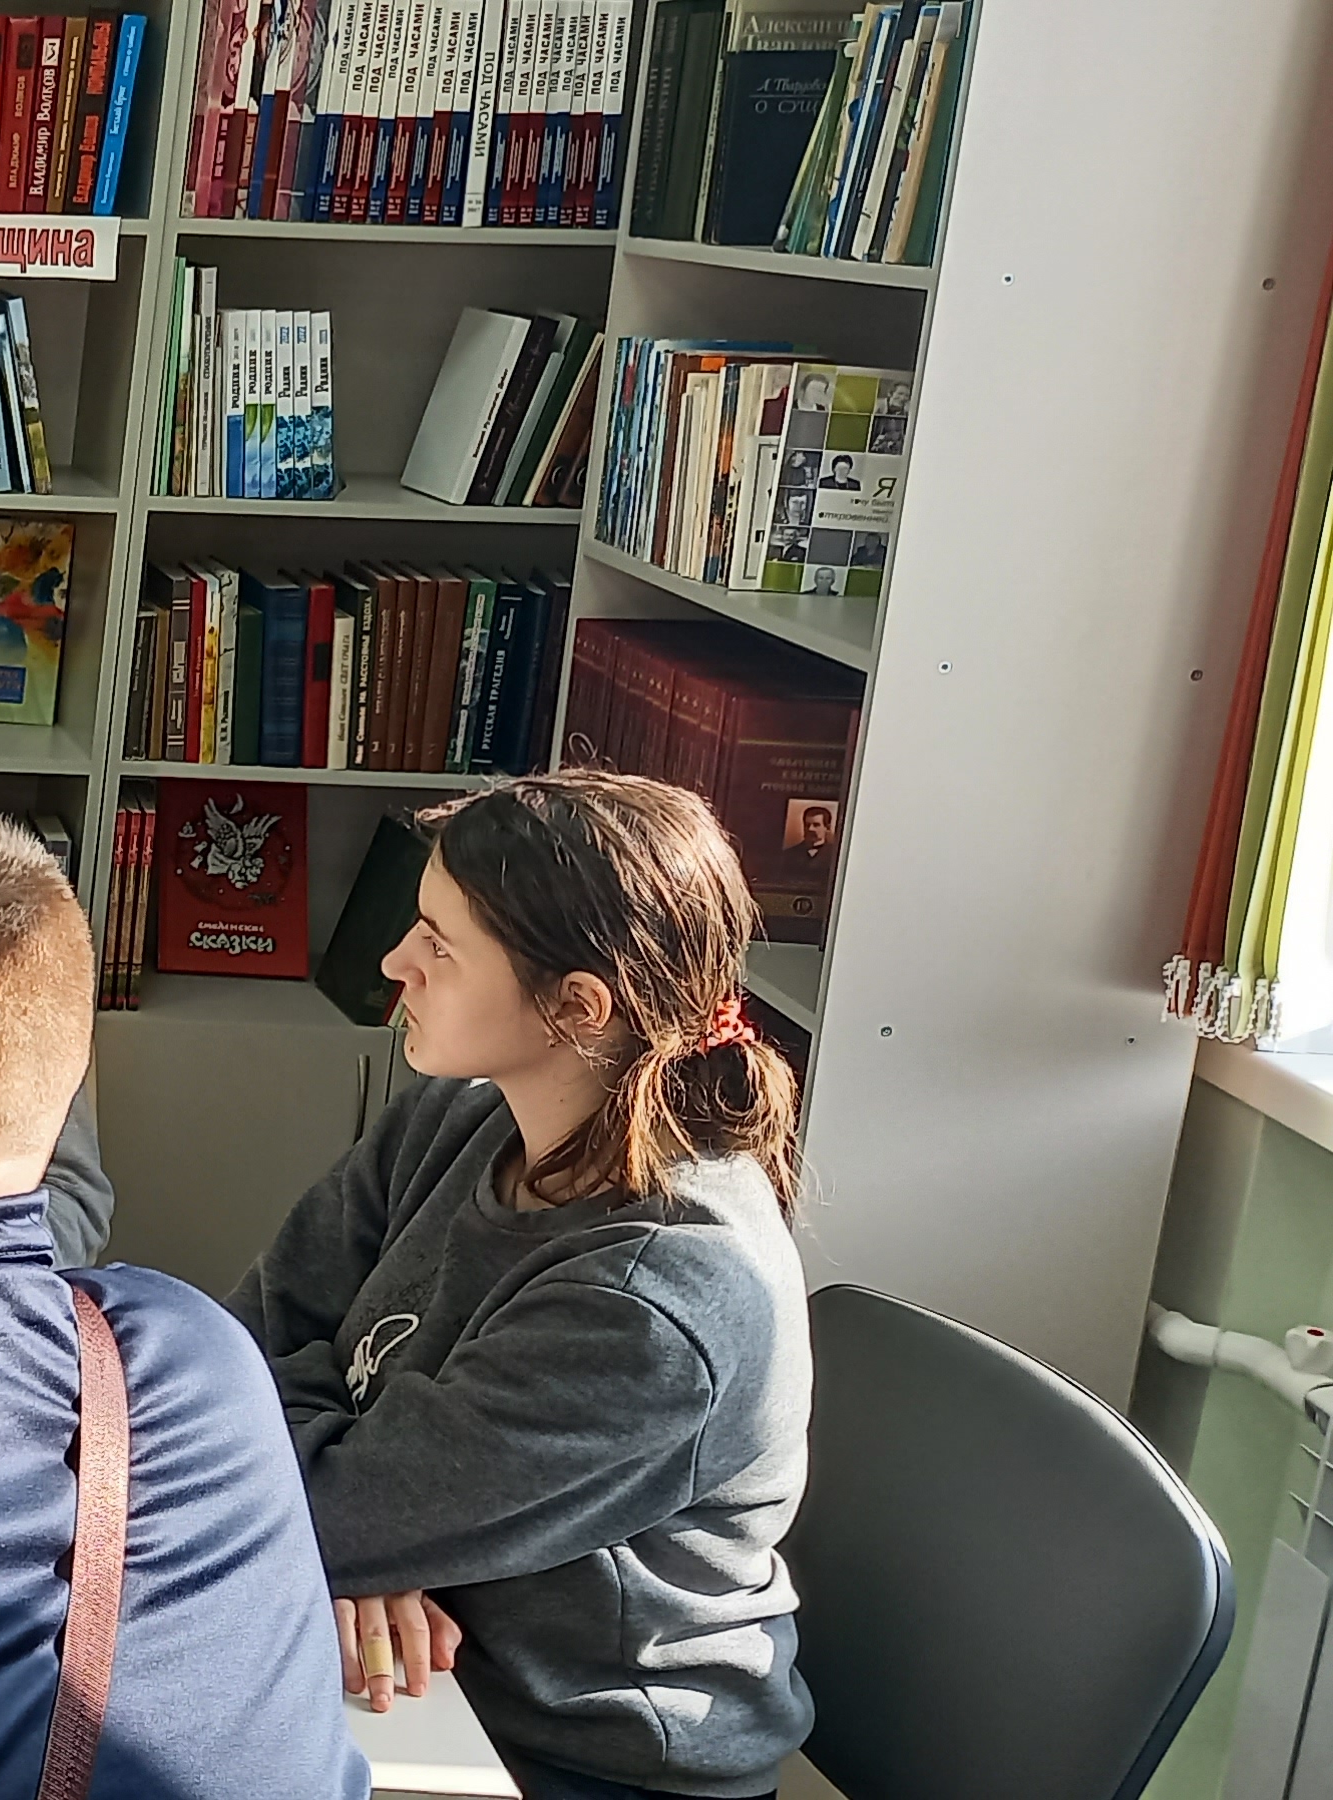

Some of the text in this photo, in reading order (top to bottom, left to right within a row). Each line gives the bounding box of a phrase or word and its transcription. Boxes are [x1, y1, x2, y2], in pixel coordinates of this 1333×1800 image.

[339, 4, 355, 73] ПОД ЧАСАМИ
[352, 2, 373, 90] ПОД ЧАСАМИ
[369, 4, 389, 92] ПОД ЧАСАМИ
[388, 9, 404, 78] ПОД ЧАСАМИ
[405, 3, 424, 92] ПОД ЧАСАМИ
[426, 7, 442, 76] ПОД ЧАСАМИ
[442, 11, 461, 93] ПОД ЧАСАМИ
[460, 12, 478, 94] ПОД ЧАСАМИ
[503, 17, 518, 92] ПОД ЧАСАМИ
[518, 14, 536, 95] ПОД ЧАСАМИ
[536, 13, 553, 95] ПОД ЧАСАМИ
[550, 17, 565, 92] ПОД ЧАСАМИ
[562, 16, 578, 91] ПОД ЧАСАМИ
[574, 15, 590, 96] ПОД ЧАСАМИ
[591, 12, 609, 94] ПОД ЧАСАМИ
[610, 17, 626, 92] ПОД ЧАСАМИ
[475, 51, 495, 157] ПОД ЧАСАМИ
[232, 364, 240, 408] РОДНИК
[249, 350, 257, 394] РОДНИК
[264, 351, 273, 395] РОДНИК
[872, 478, 897, 498] Я
[481, 650, 505, 749] РУССКАЯ ТРАГЕДИЯ
[189, 932, 273, 954] СКАЗКИ
